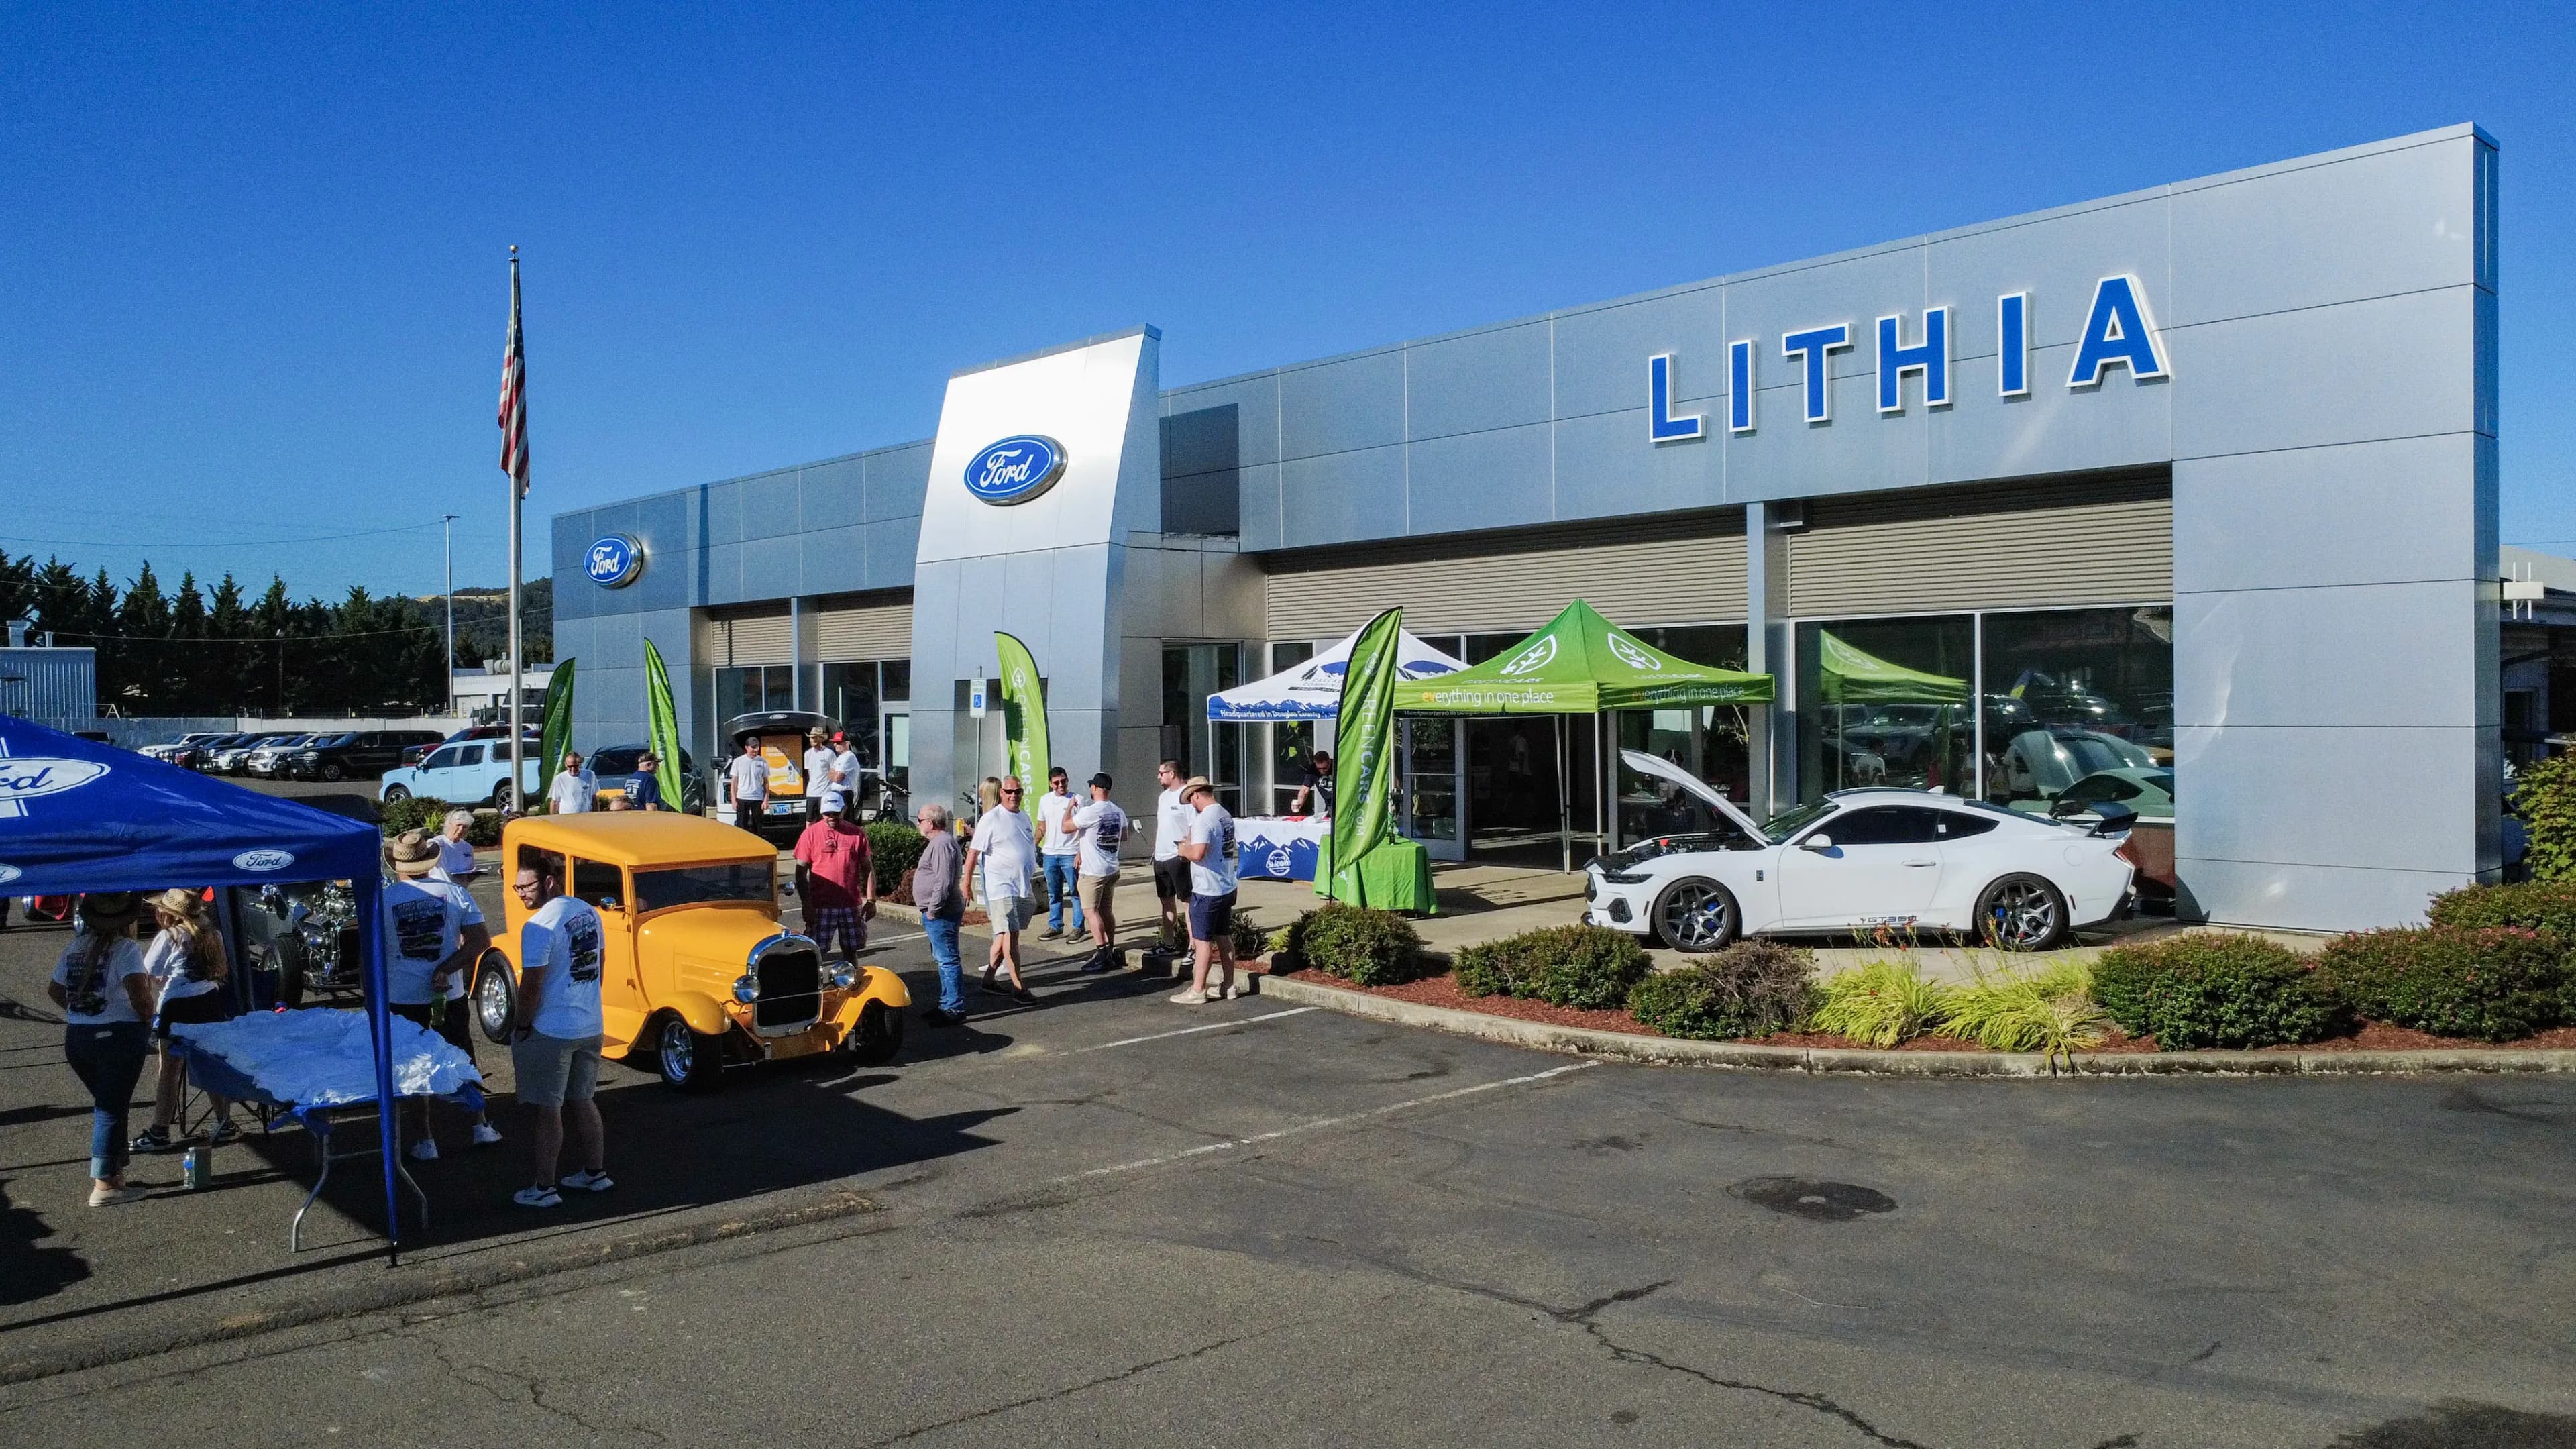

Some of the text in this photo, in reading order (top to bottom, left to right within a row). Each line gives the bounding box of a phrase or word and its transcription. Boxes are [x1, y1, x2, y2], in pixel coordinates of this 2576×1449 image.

[1648, 273, 2174, 443] LITHIA
[979, 449, 1034, 488] Ford
[591, 546, 620, 576] Ford
[1422, 688, 1554, 706] everything in one place
[1631, 684, 1745, 704] everything in one place
[1220, 710, 1265, 719] Headquartered
[246, 853, 282, 867] Ford
